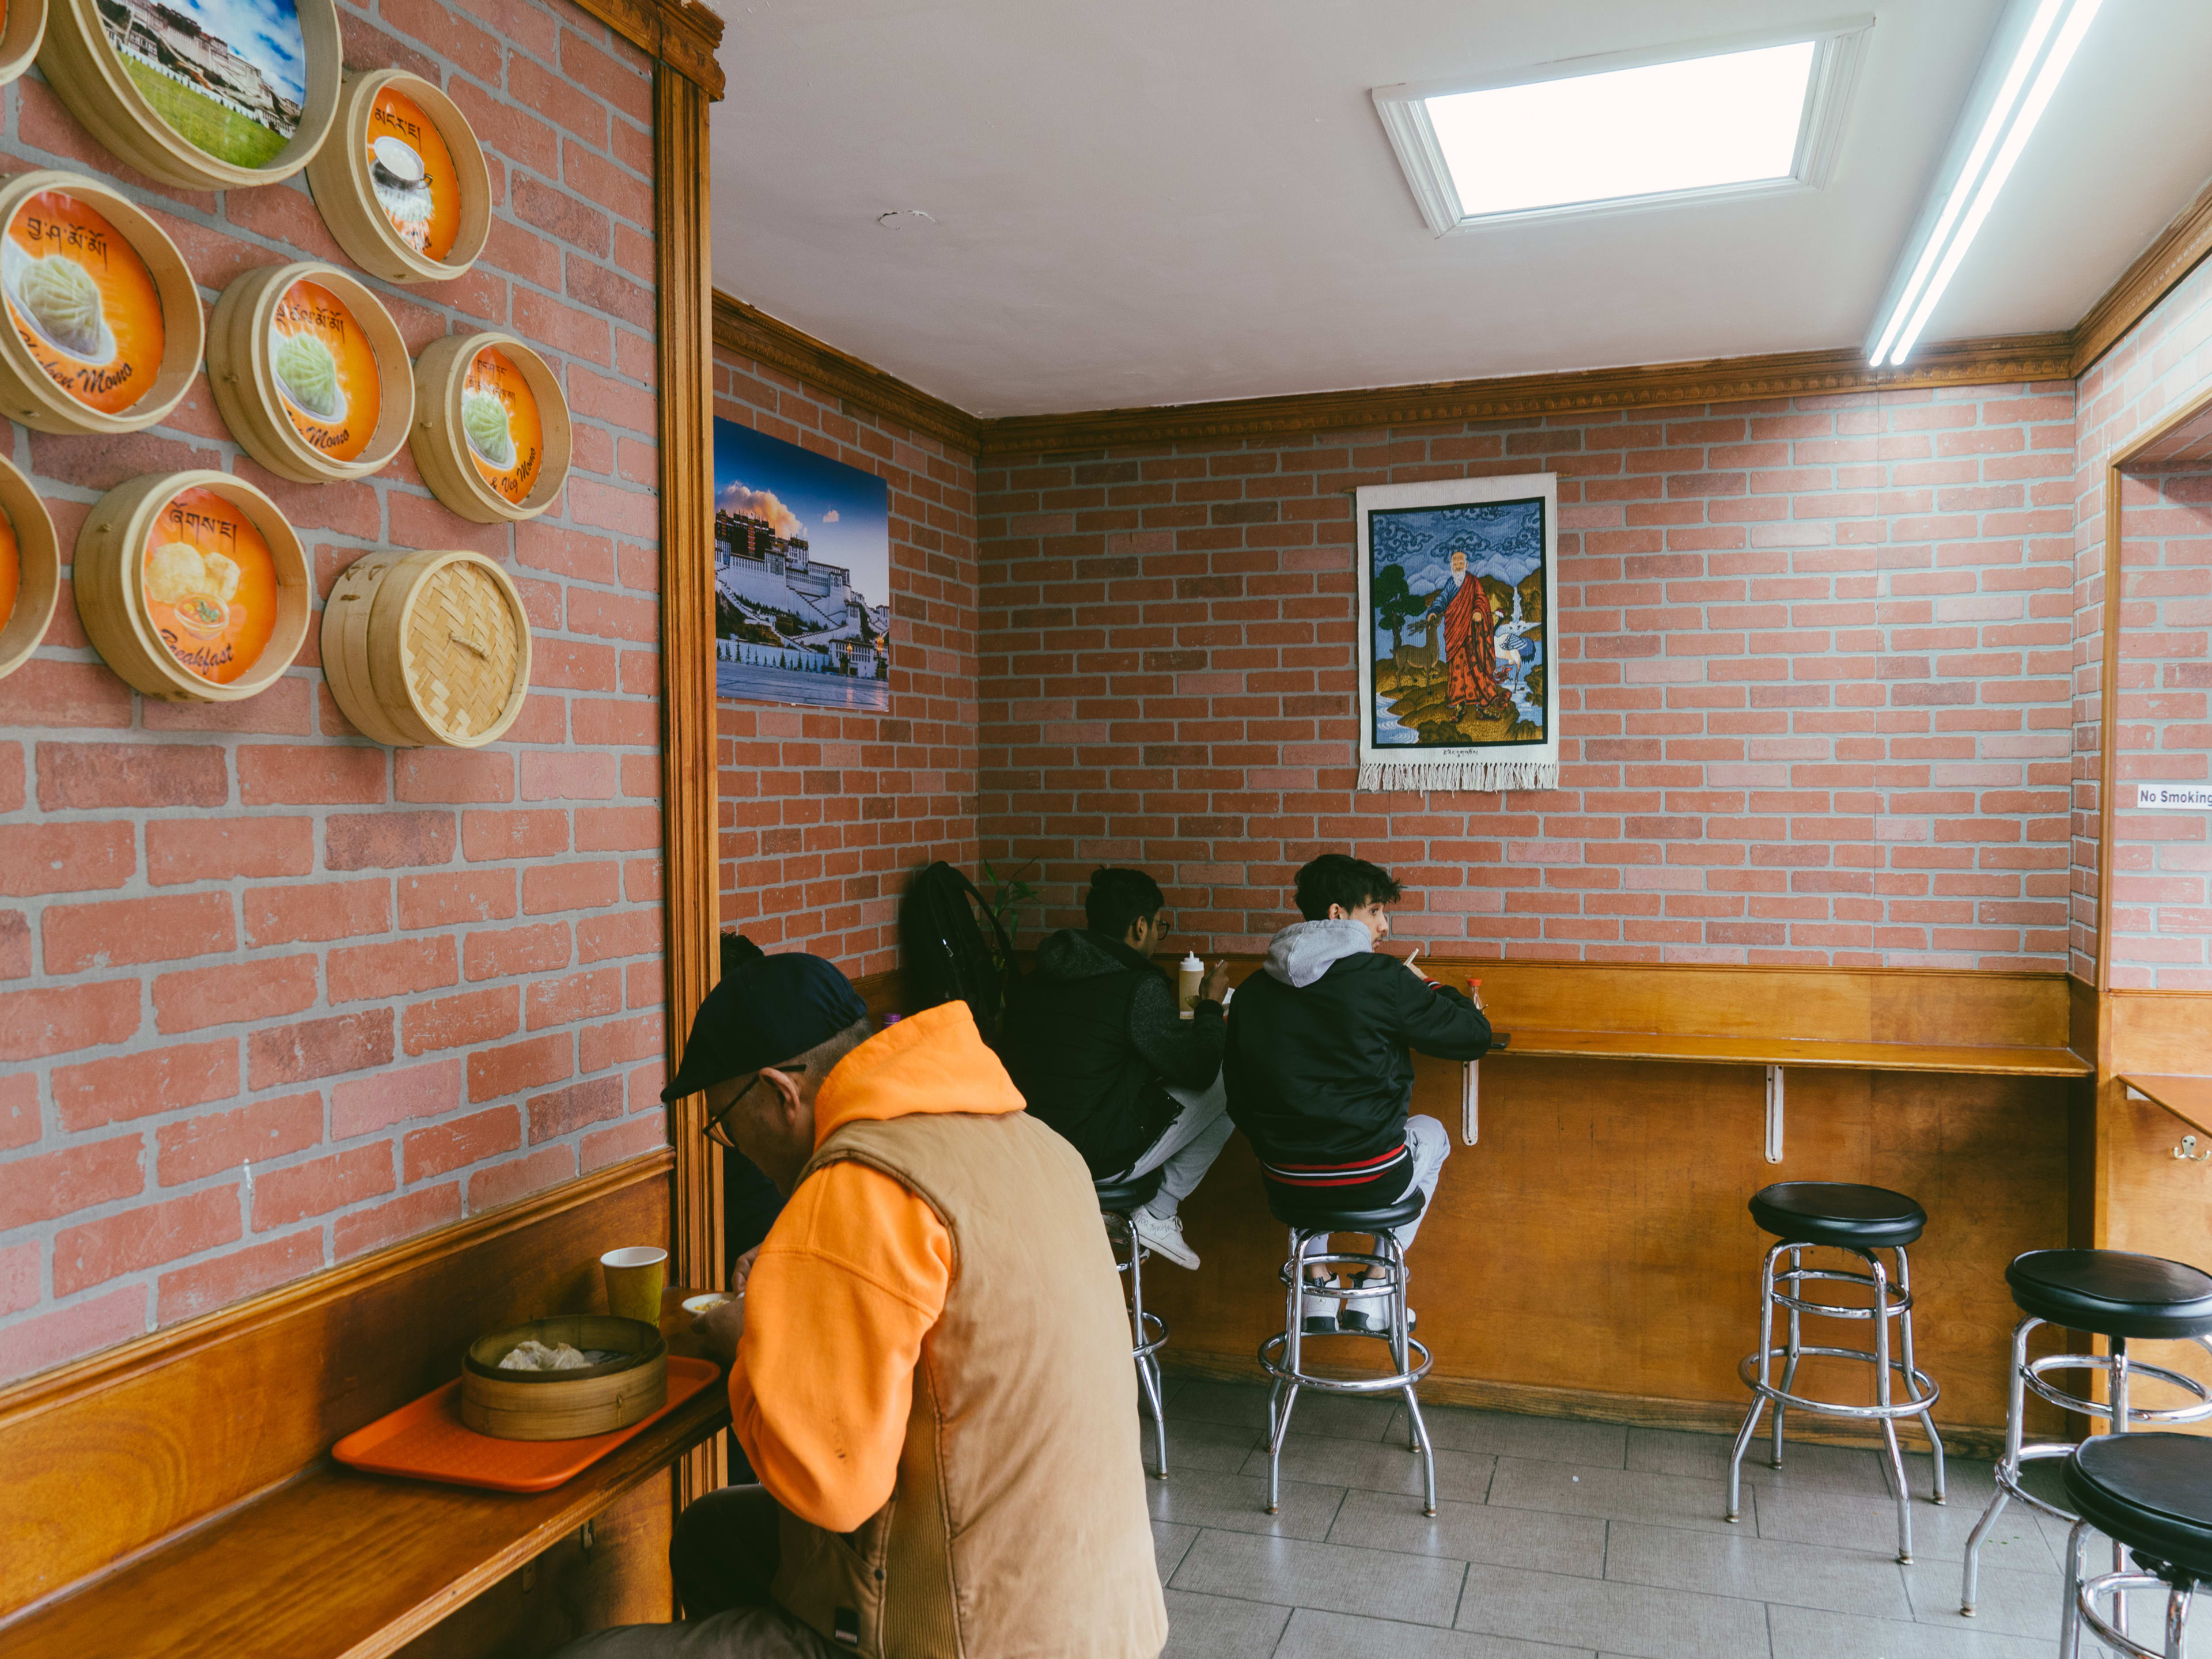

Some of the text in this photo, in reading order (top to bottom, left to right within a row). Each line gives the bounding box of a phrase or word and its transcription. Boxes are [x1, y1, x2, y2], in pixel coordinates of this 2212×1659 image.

[77, 362, 133, 393] Momo
[306, 426, 350, 449] Momo
[502, 477, 517, 493] Veg
[517, 447, 536, 482] Momo
[2141, 790, 2212, 806] No Smoking
